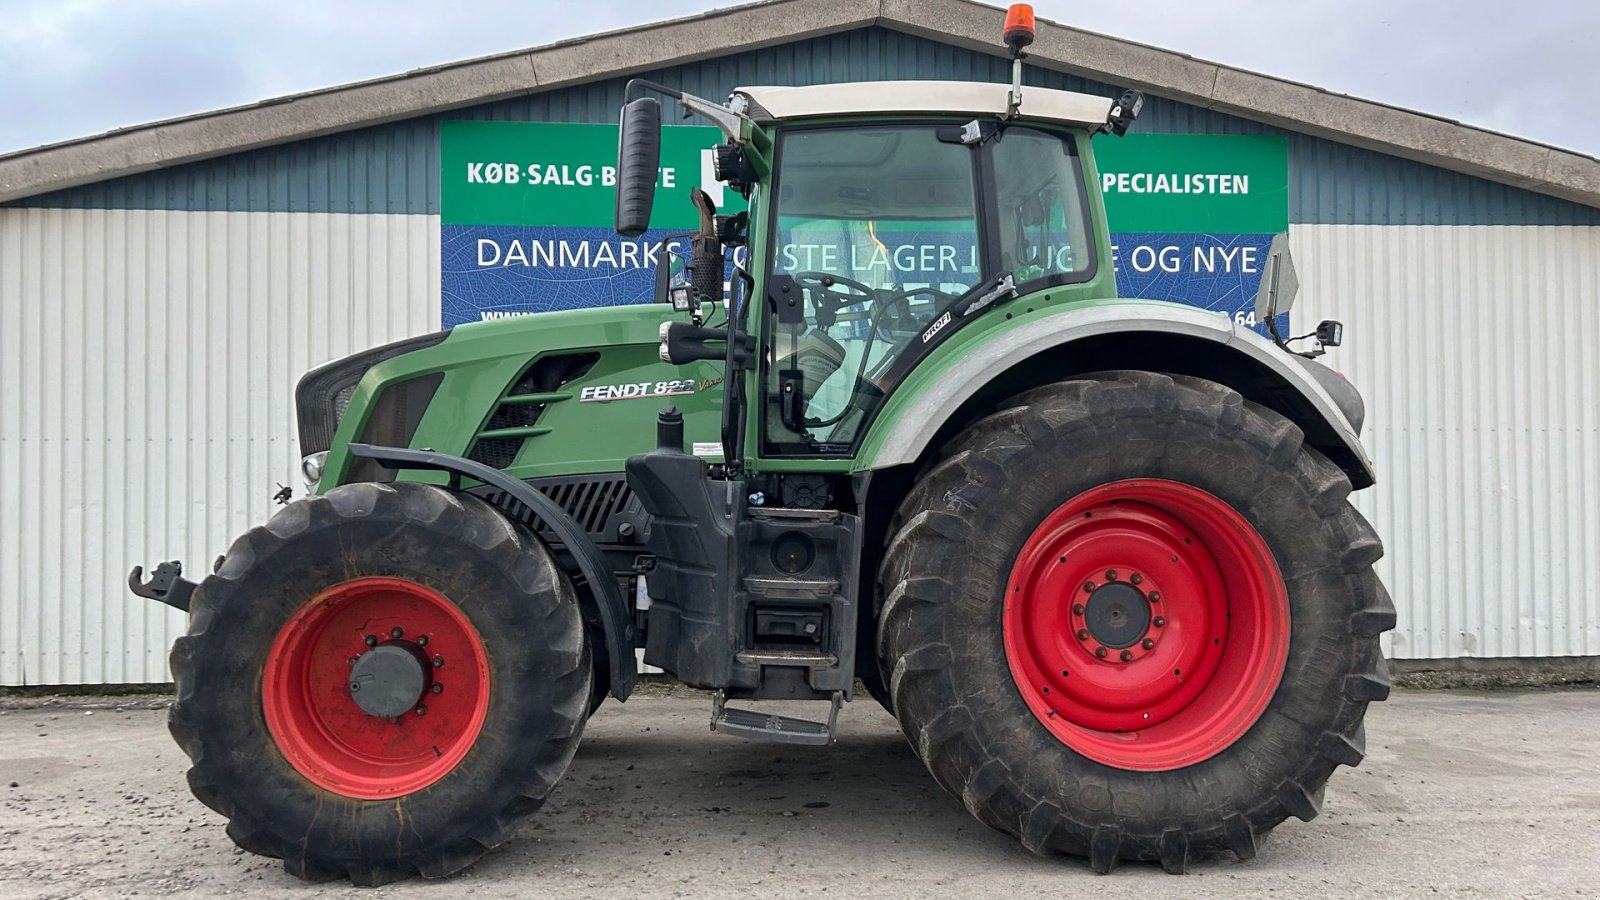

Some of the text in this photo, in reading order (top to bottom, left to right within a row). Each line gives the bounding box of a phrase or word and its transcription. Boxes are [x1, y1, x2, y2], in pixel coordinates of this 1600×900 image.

[1098, 173, 1249, 195] PECIALISTEN
[851, 244, 958, 272] LAGER
[1131, 245, 1181, 273] OG
[1194, 247, 1257, 274] NYE
[923, 312, 950, 341] PROFI
[580, 382, 652, 399] FENDT
